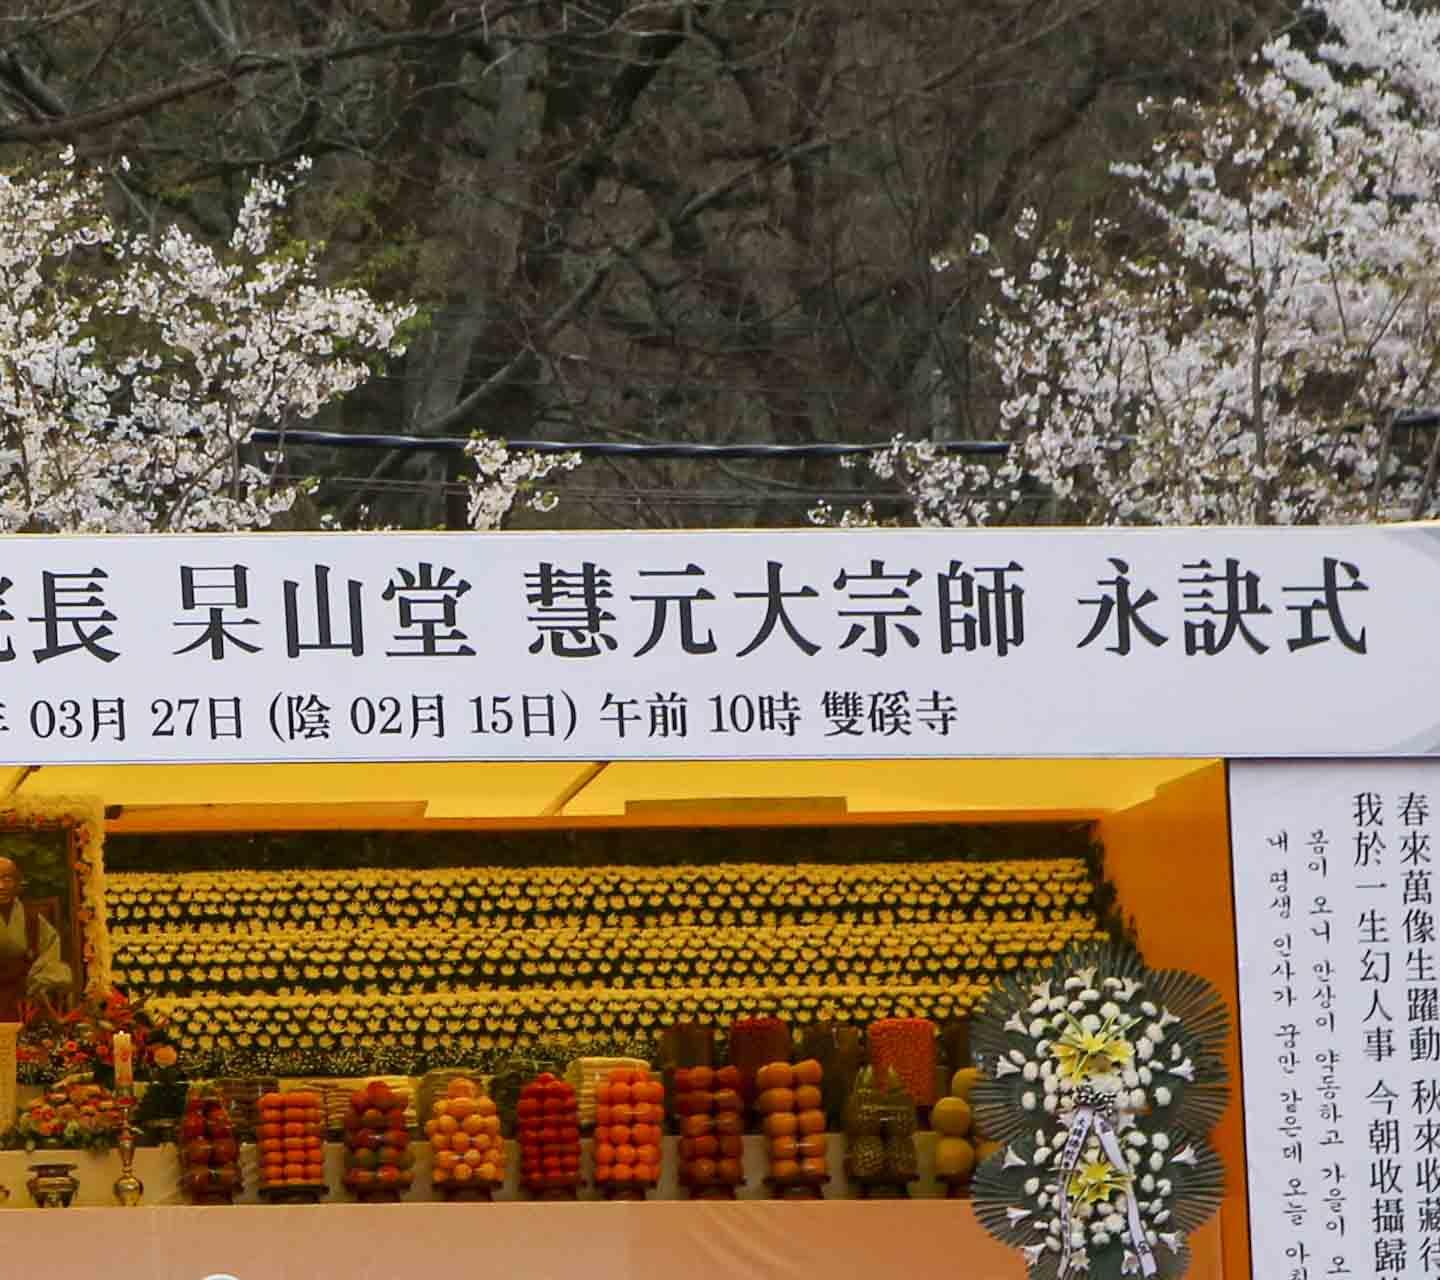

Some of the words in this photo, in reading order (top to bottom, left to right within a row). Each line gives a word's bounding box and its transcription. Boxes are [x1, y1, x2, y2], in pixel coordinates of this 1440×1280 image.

[172, 561, 477, 661] 杲山堂
[523, 559, 1025, 658] 慧元大宗師
[1076, 556, 1369, 657] 永訣式
[29, 696, 126, 742] 03月
[150, 696, 242, 740] 27日
[269, 691, 331, 743] (陰
[350, 693, 445, 739] 02月
[469, 690, 577, 741] 15日)
[599, 691, 688, 738] 午前
[708, 690, 802, 737] 10時
[821, 689, 958, 737] 雙磎寺
[1352, 791, 1397, 1063] 我於一生幻人事
[1397, 791, 1440, 1062] 春來萬像生躍動
